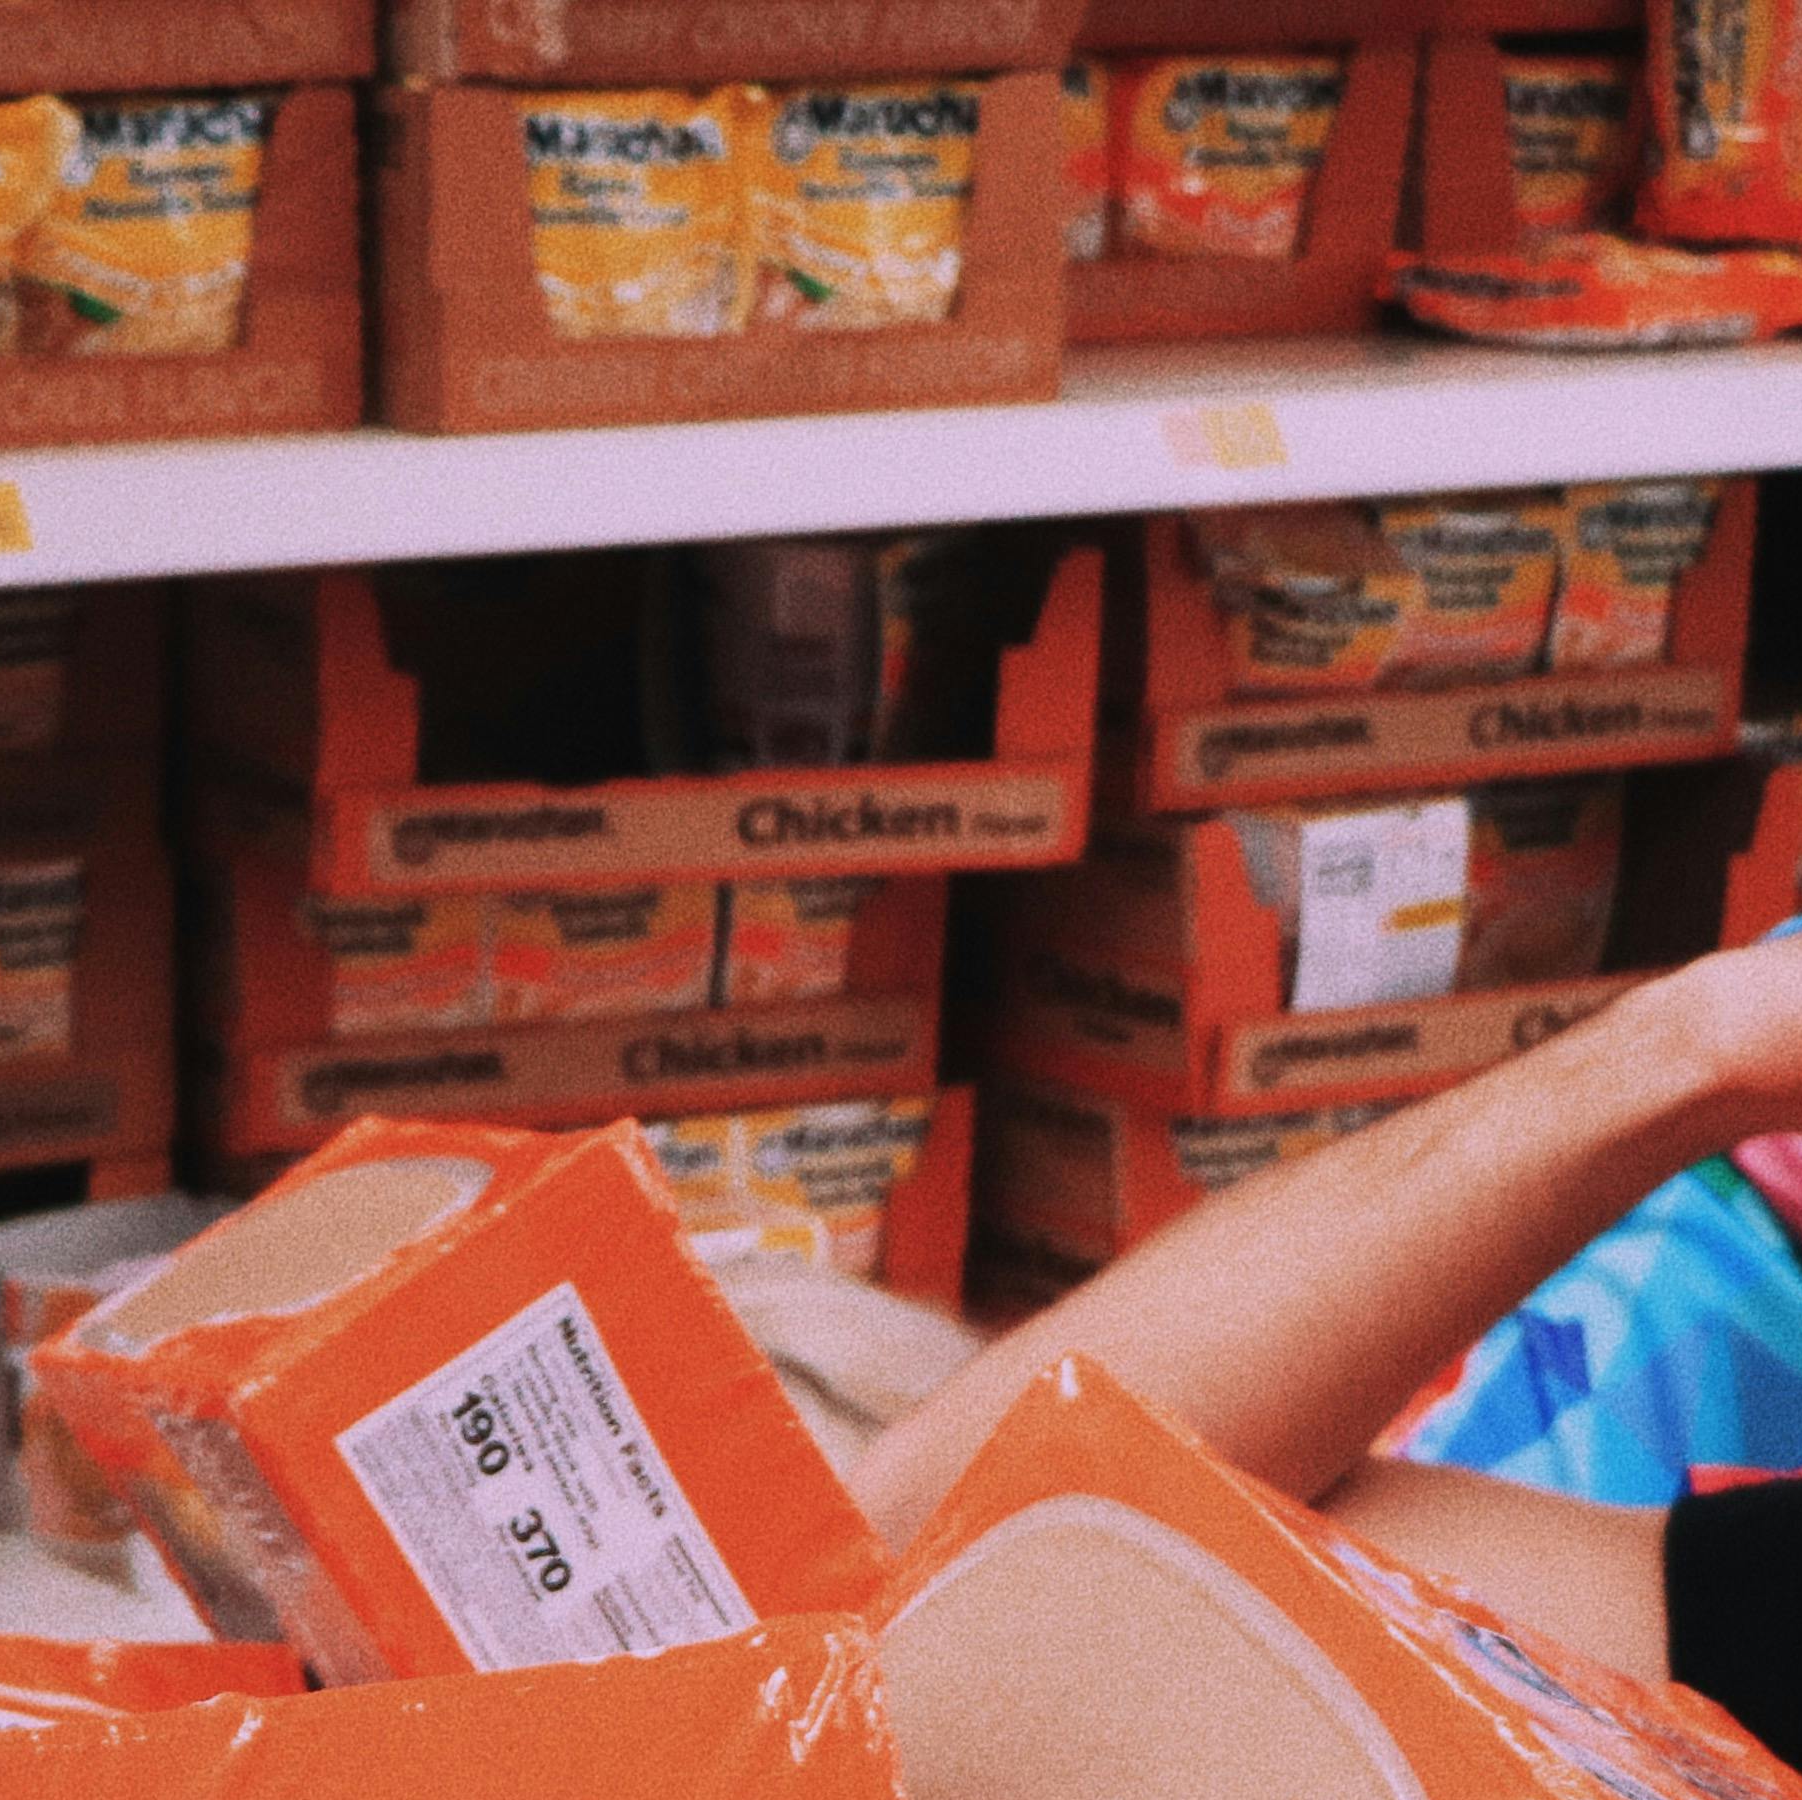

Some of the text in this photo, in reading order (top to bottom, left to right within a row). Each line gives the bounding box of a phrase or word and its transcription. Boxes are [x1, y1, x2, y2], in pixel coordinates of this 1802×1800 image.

[1470, 700, 1642, 748] Chicken
[738, 795, 959, 846] Chicken
[621, 1030, 827, 1083] Chicken
[559, 1316, 667, 1519] Nutrition Facts
[451, 1390, 573, 1594] 190 370
